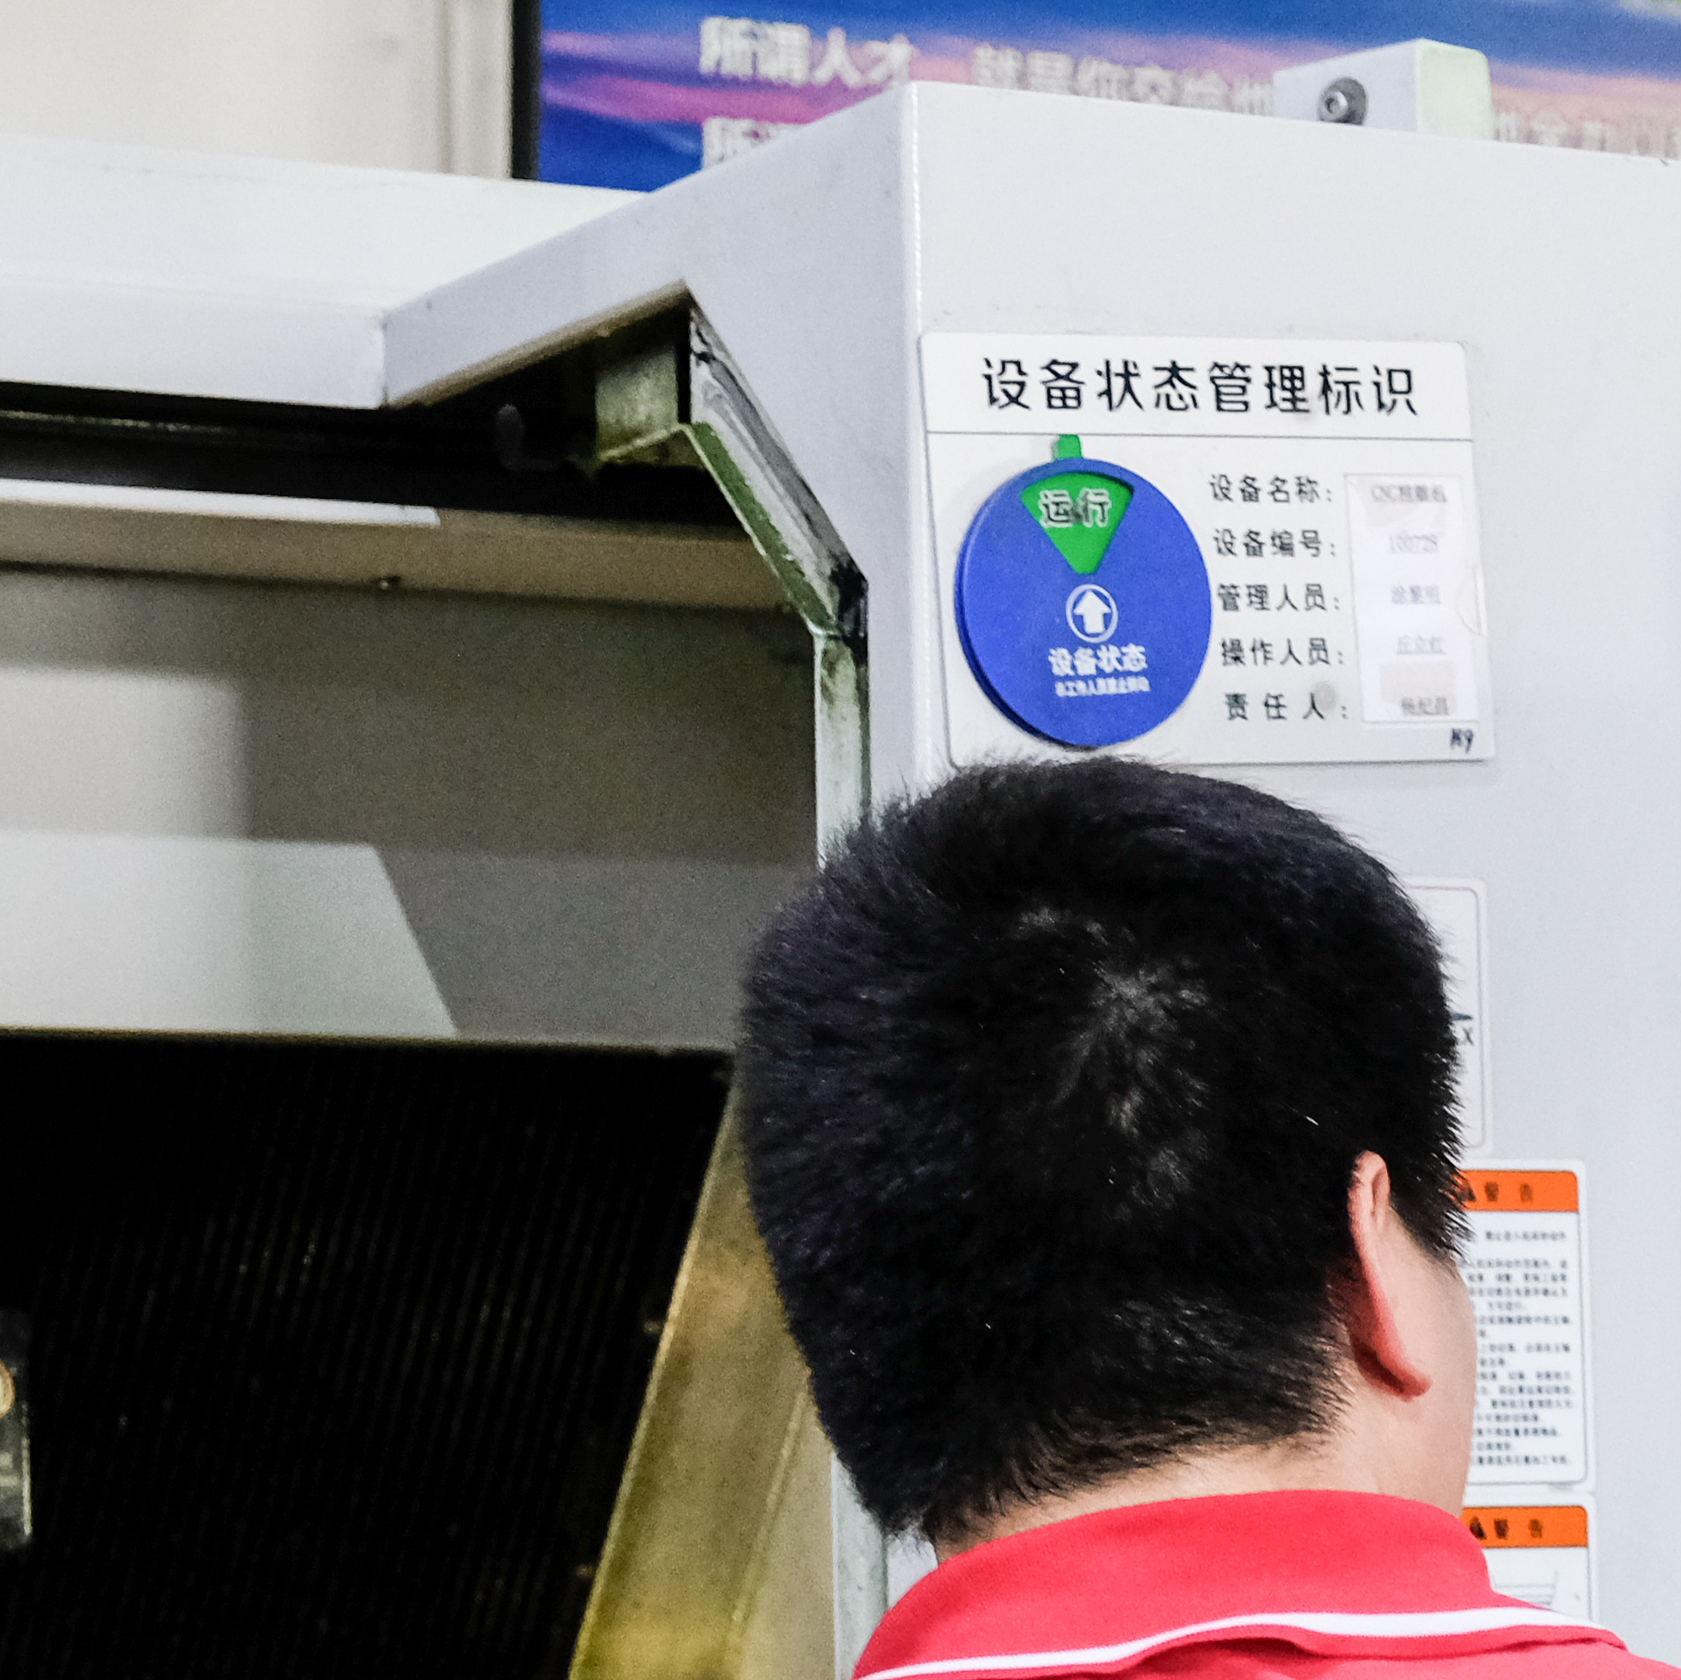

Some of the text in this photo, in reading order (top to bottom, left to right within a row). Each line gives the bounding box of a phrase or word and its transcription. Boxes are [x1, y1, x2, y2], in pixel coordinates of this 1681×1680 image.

[982, 358, 1419, 417] 设备状态管理标识
[1038, 487, 1113, 528] 运行
[1048, 642, 1149, 677] 设备状态
